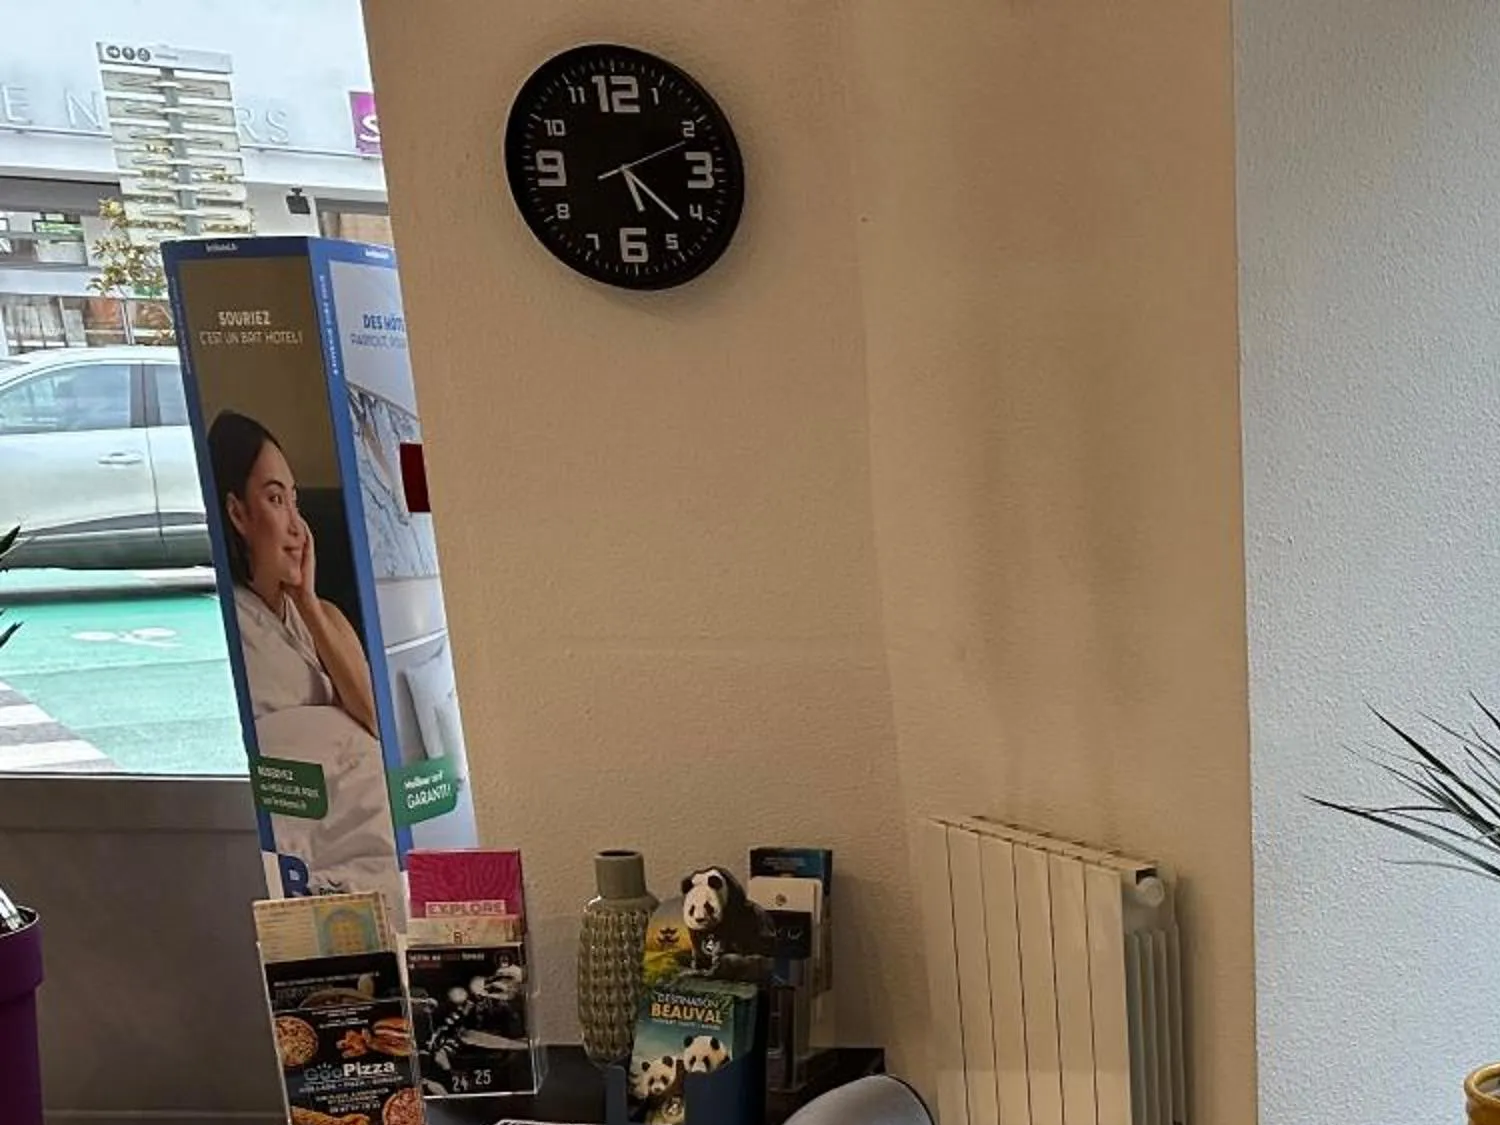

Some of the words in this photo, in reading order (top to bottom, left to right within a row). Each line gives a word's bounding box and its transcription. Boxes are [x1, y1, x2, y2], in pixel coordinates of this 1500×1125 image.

[568, 86, 586, 104] 11
[591, 75, 641, 113] 12
[650, 87, 660, 105] 1
[544, 119, 566, 136] 10
[681, 120, 696, 137] 2
[535, 150, 567, 187] 9
[684, 151, 715, 189] 3
[556, 203, 571, 219] 8
[689, 204, 703, 221] 4
[585, 233, 600, 251] 7
[619, 227, 649, 263] 6
[665, 233, 679, 250] 5
[217, 310, 271, 327] SOURIEZ
[363, 314, 383, 330] DES
[427, 901, 504, 916] EXPLORE
[650, 1002, 724, 1025] BEAUVAL
[452, 1075, 469, 1092] 24
[475, 1069, 492, 1085] 25
